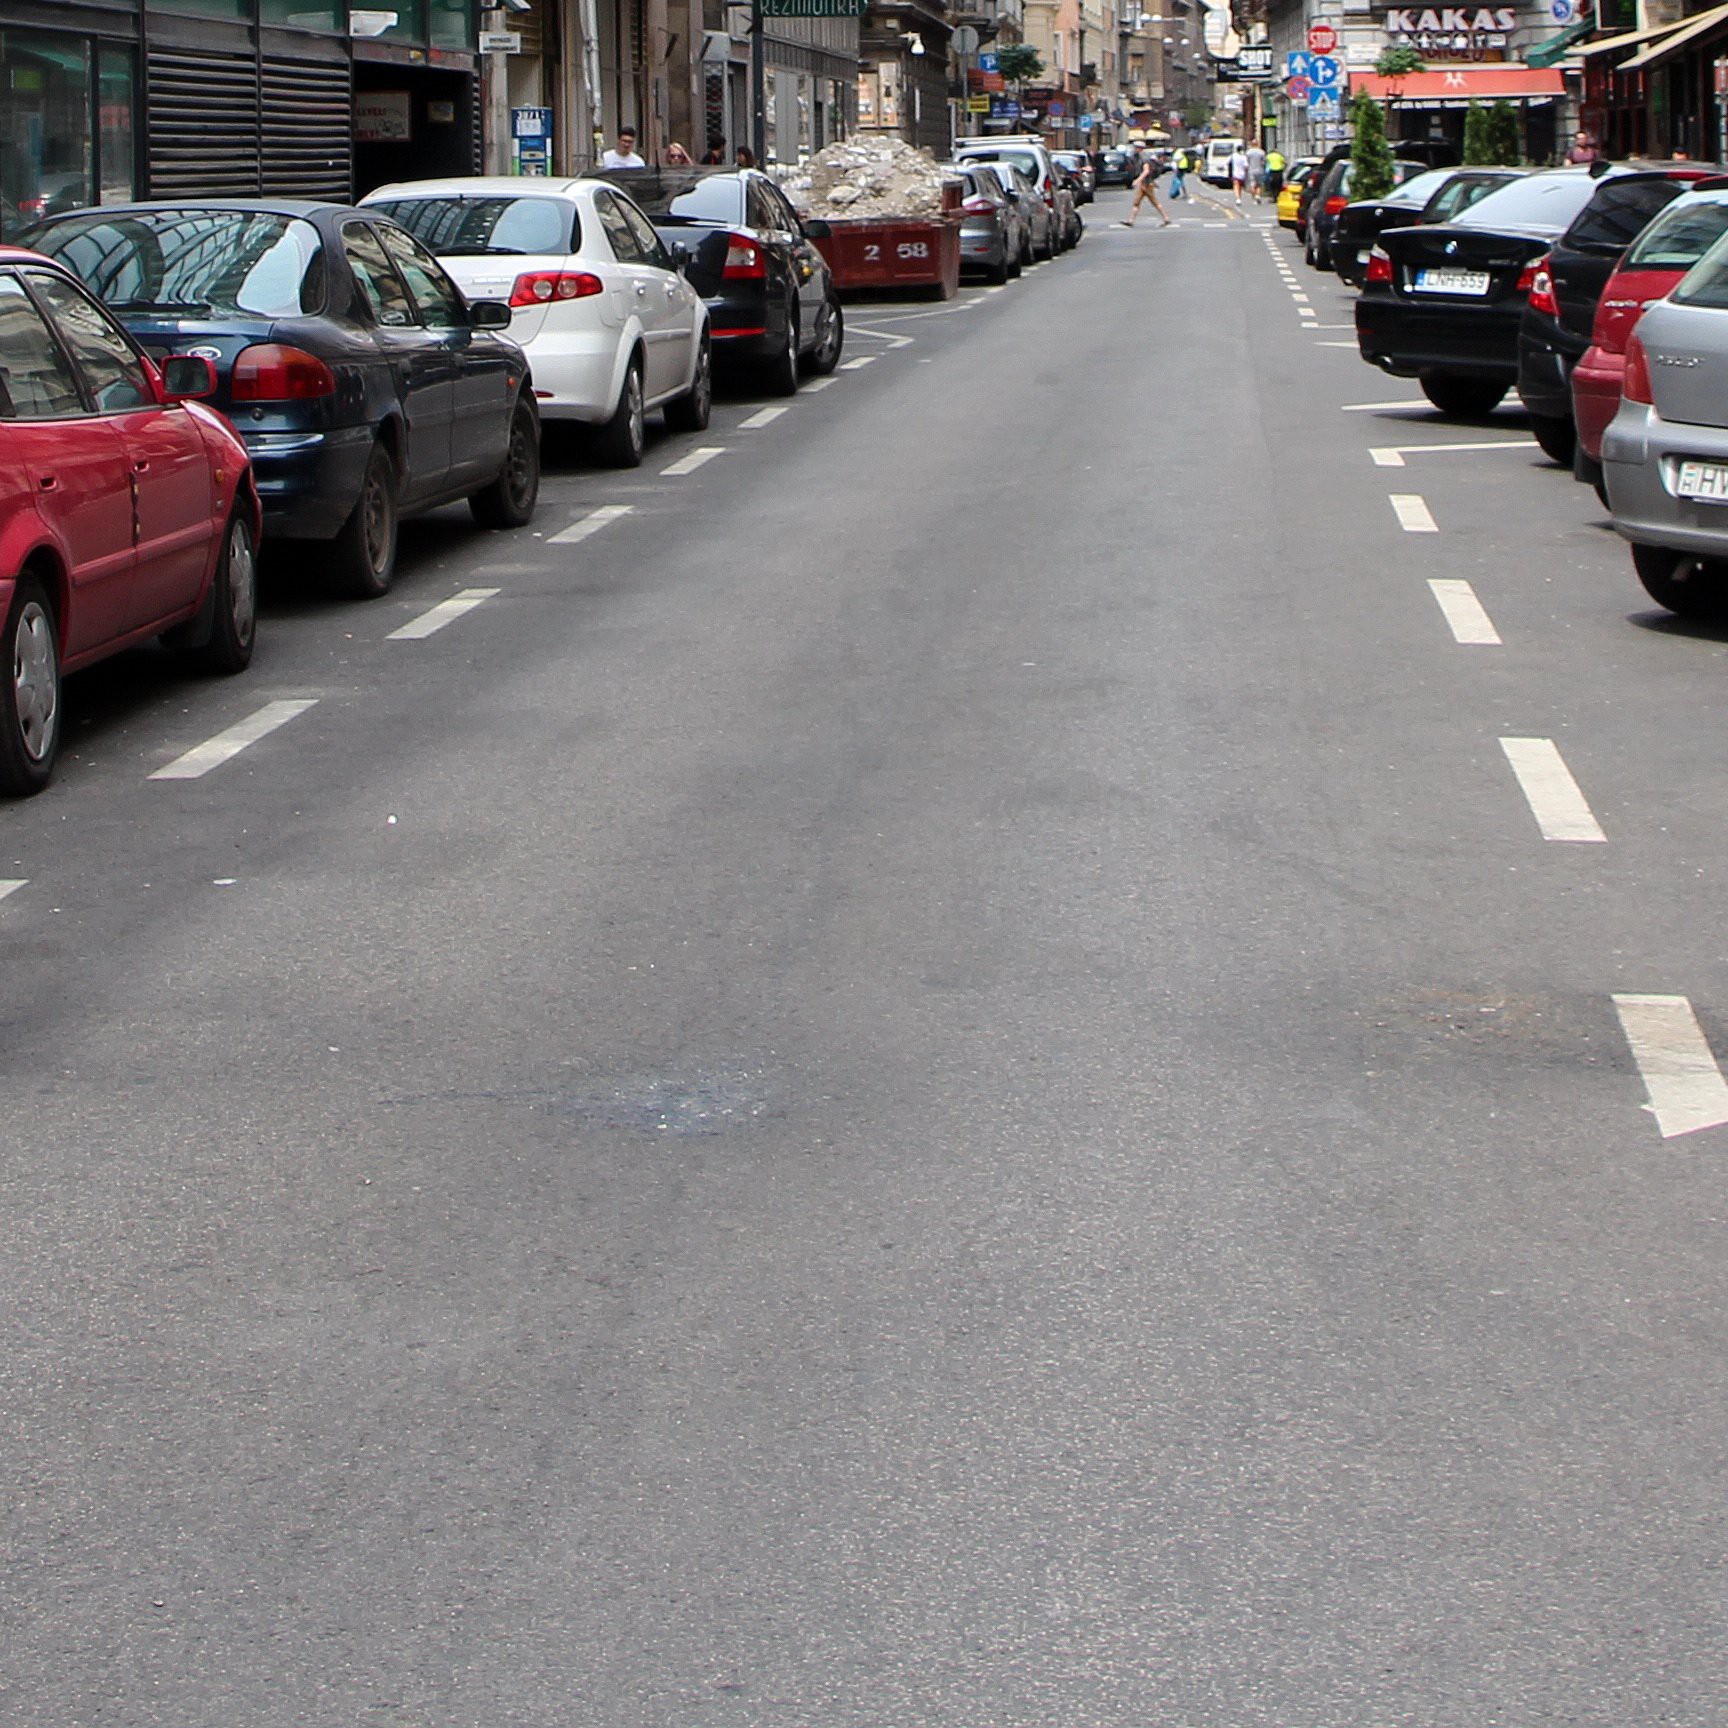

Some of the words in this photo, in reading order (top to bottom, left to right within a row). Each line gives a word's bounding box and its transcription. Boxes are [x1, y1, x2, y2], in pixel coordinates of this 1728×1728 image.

[1386, 7, 1516, 33] KAKAS
[864, 245, 880, 261] 2
[897, 242, 929, 259] 58
